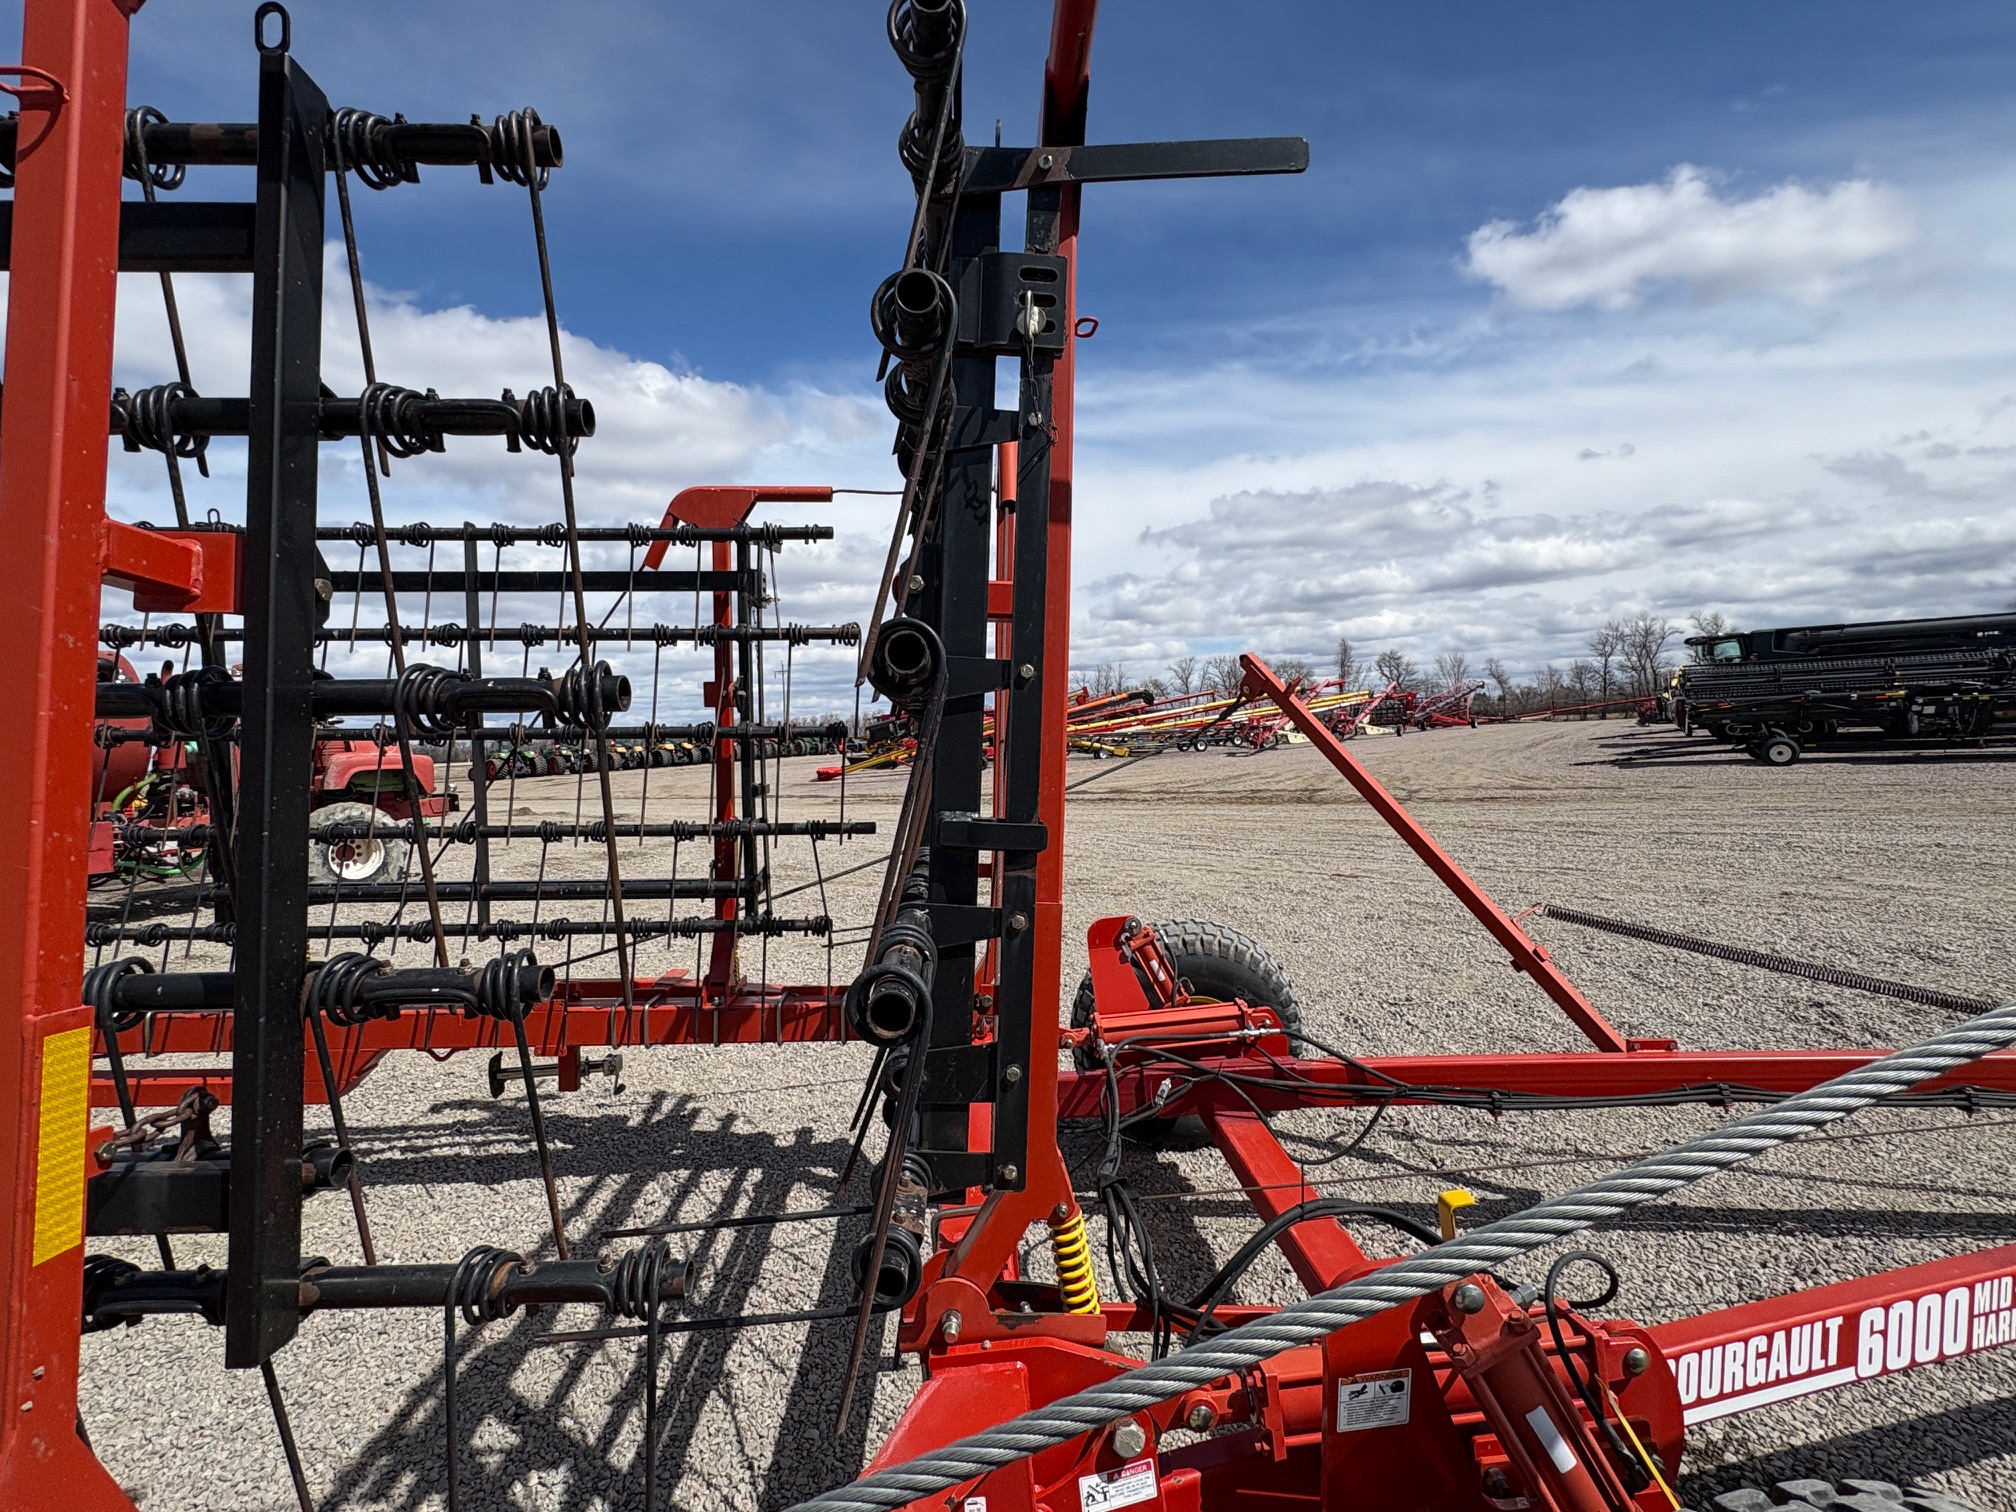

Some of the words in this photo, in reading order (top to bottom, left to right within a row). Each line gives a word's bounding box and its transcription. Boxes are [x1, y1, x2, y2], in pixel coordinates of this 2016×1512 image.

[1666, 1316, 1843, 1405] OURGAULT
[1857, 1286, 1970, 1378] 6000
[1361, 1371, 1402, 1382] WARNING
[1121, 1464, 1147, 1477] DANGER
